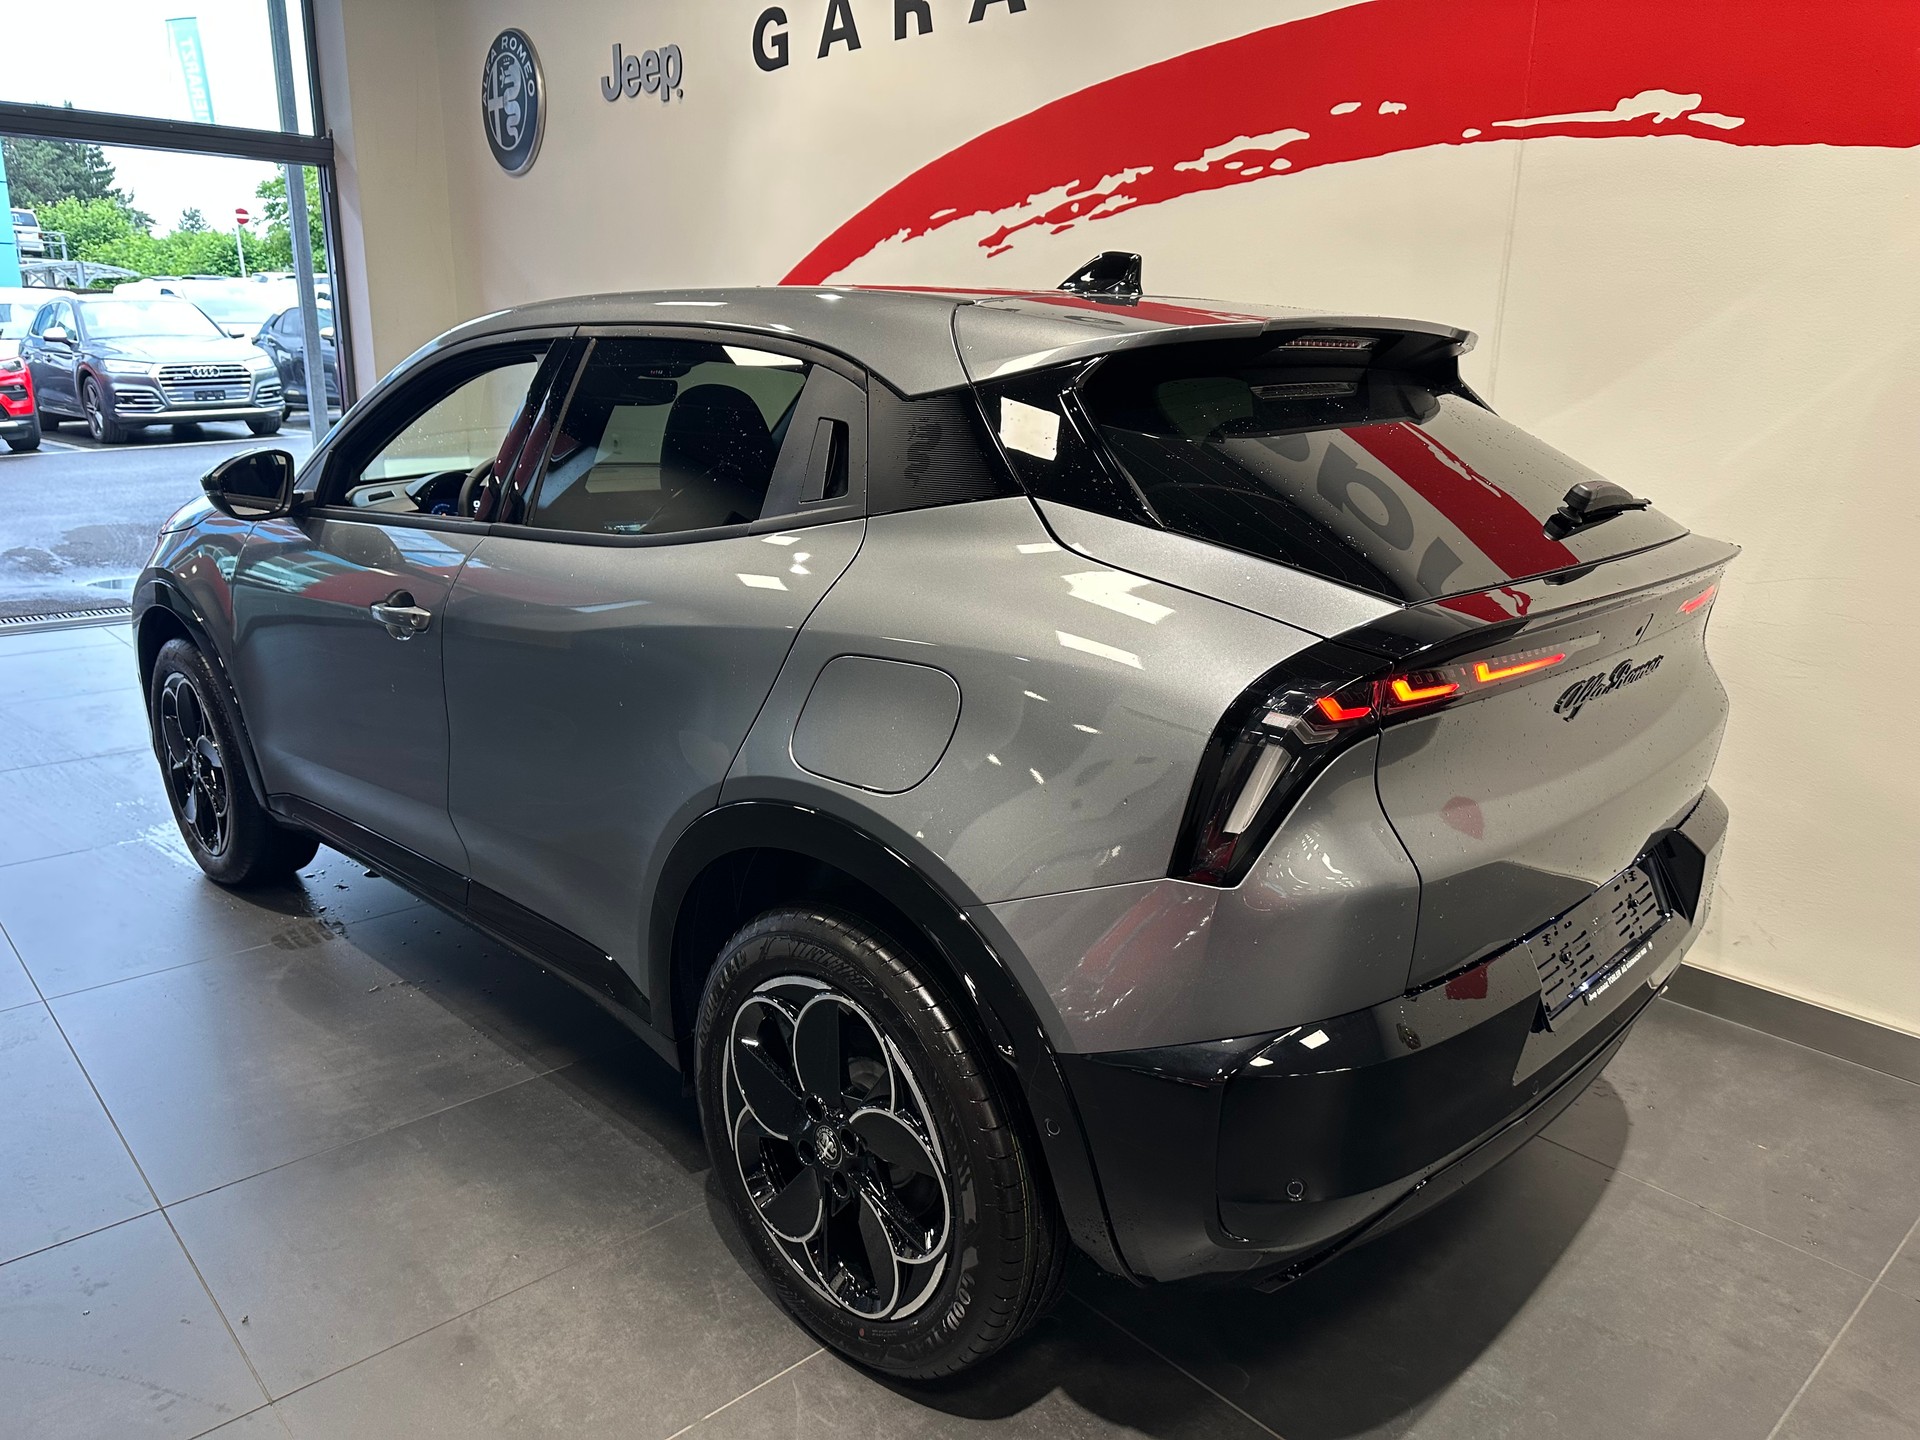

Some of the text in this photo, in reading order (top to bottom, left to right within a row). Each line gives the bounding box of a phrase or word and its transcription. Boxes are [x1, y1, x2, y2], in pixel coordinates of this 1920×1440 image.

[482, 35, 536, 107] ALFA ROMEO
[601, 43, 683, 102] Jeep
[1552, 655, 1665, 722] Alfa Romeo
